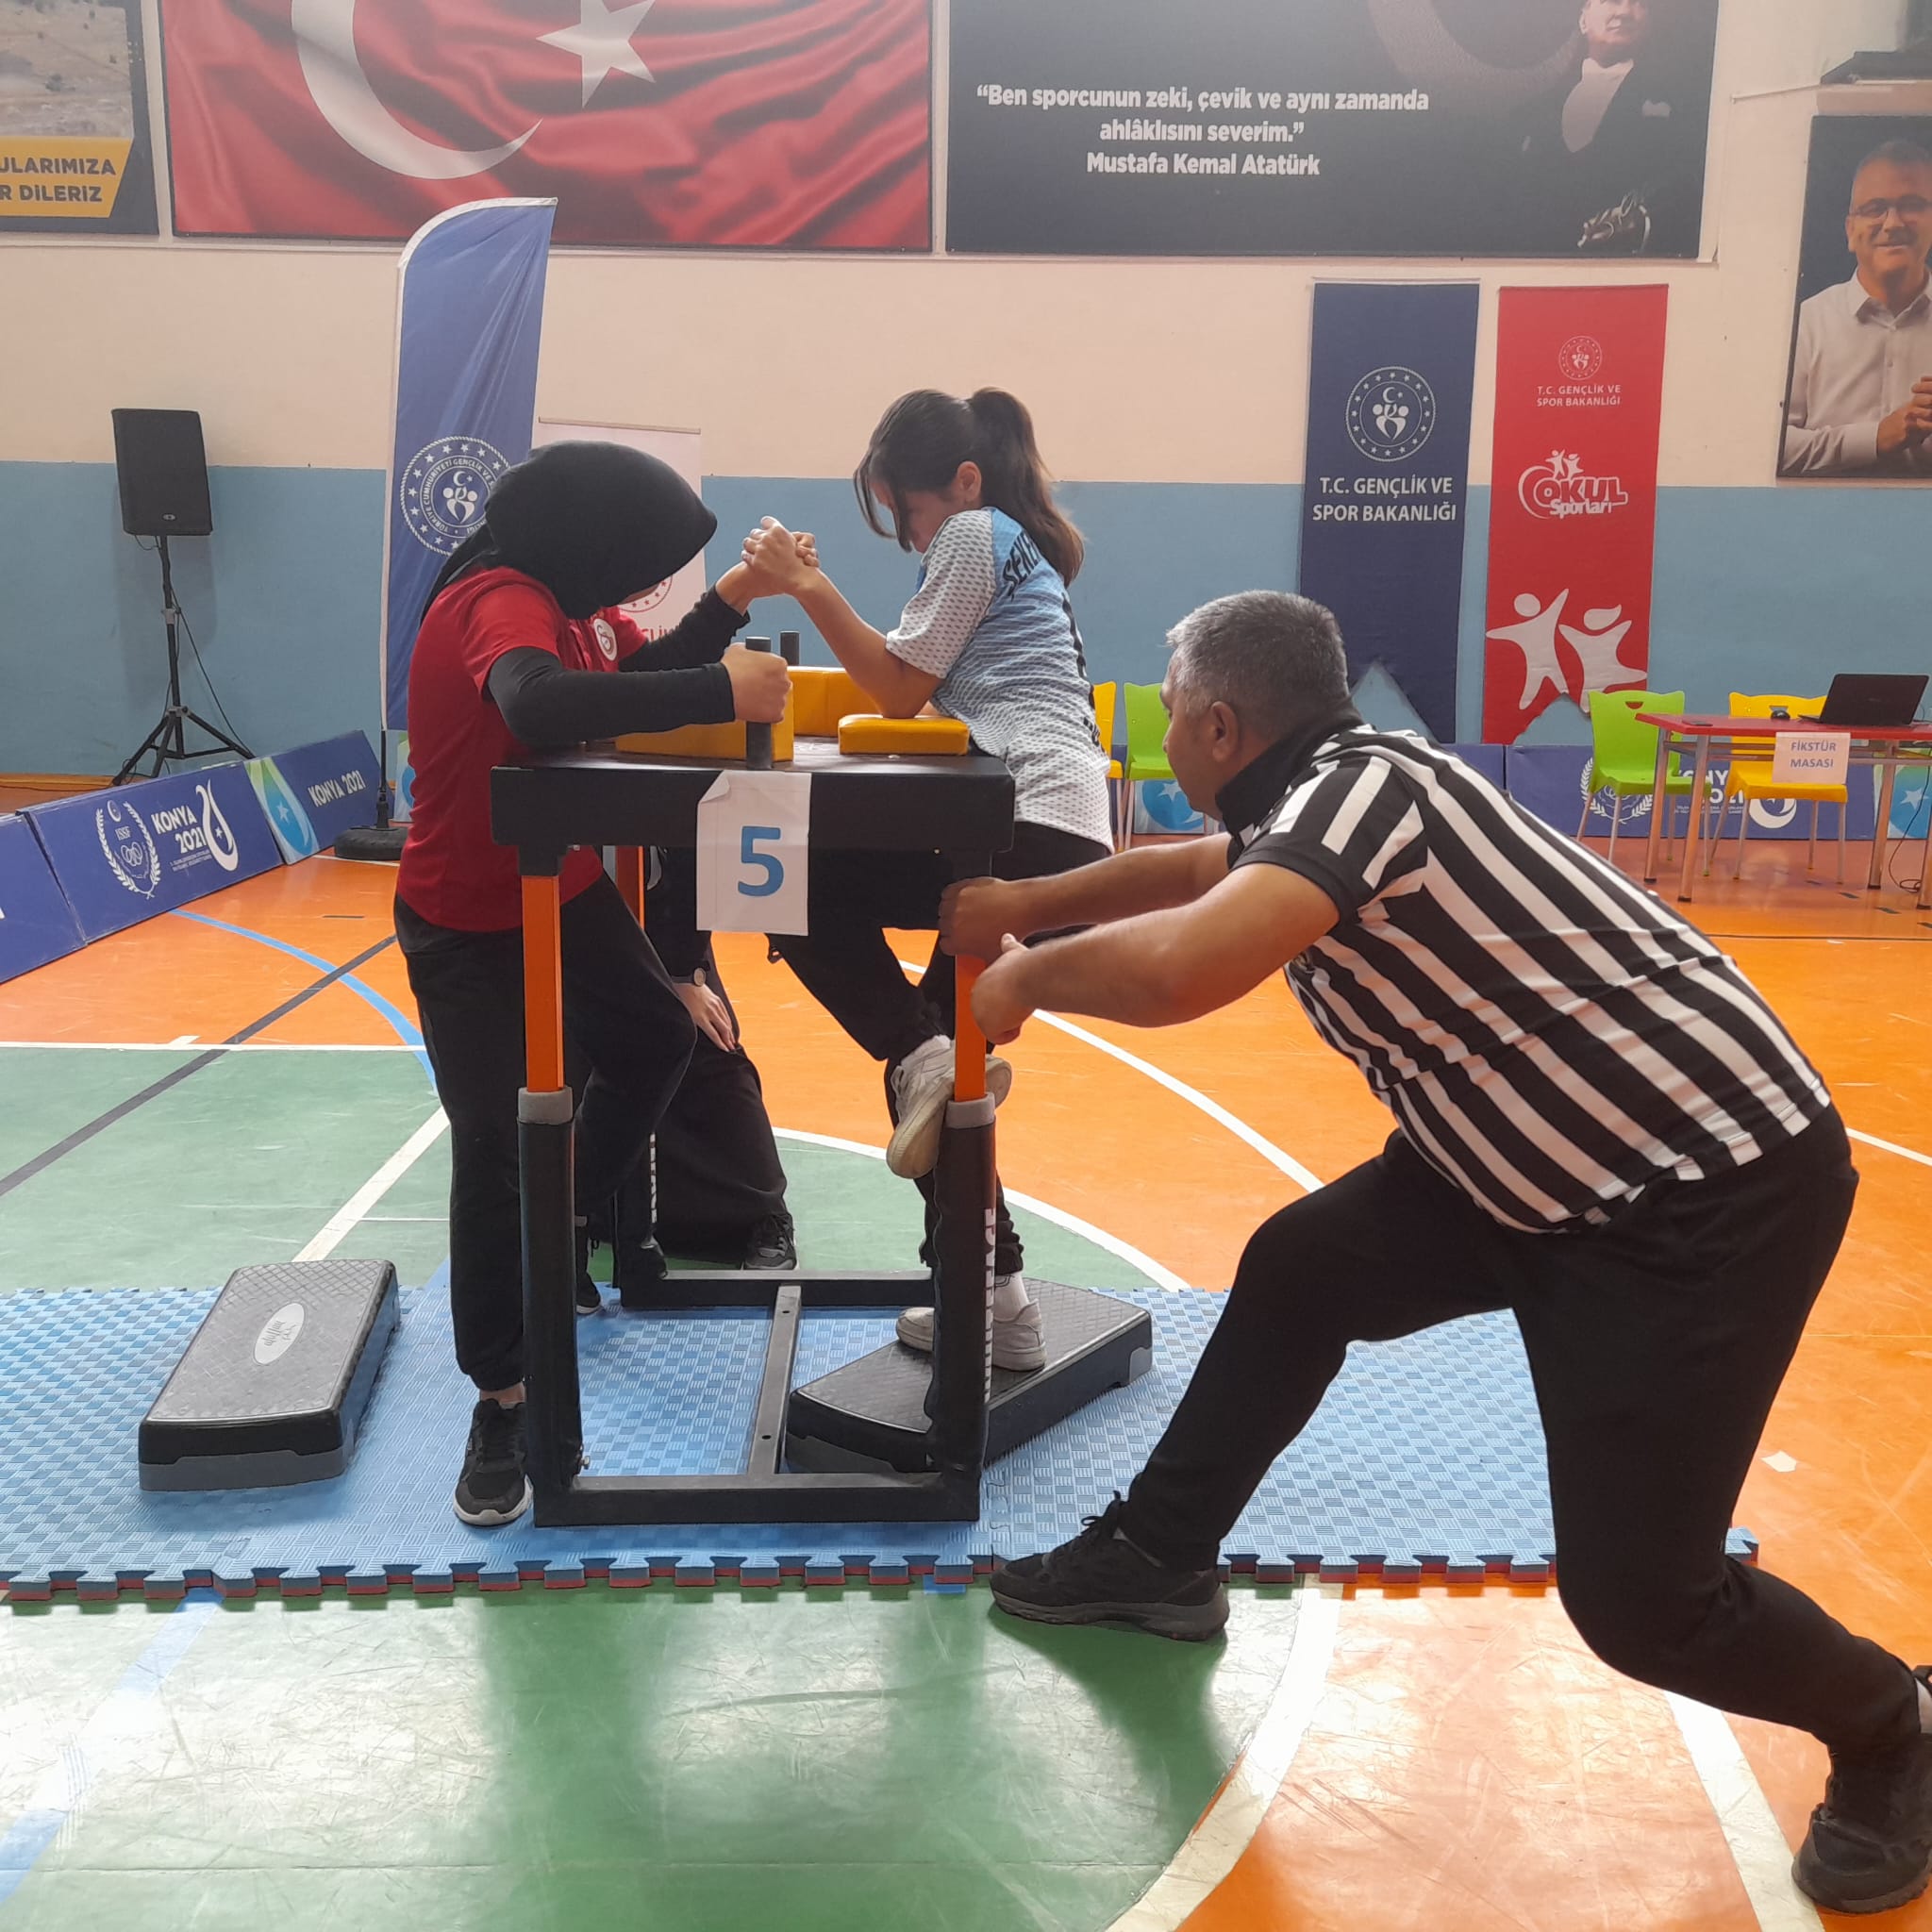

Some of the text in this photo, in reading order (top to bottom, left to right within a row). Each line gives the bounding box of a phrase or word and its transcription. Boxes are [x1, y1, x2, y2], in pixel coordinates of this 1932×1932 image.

[977, 85, 1429, 113] “Ben sporcunun zeki, çevik ve aynı zamanda
[1100, 119, 1304, 142] ahlâklısını severim.”
[1087, 152, 1321, 175] Mustafa Kemal Atatürk
[19, 184, 102, 202] DİLERİZ
[1537, 395, 1621, 407] SPOR BAKANLIĞI
[1538, 384, 1621, 396] T.C. GENÇLİK VE
[1320, 474, 1453, 498] T.C. GENÇLİK VE
[1533, 476, 1628, 508] OKUL
[1312, 501, 1457, 522] SPOR BAKANLIĞI
[1790, 740, 1837, 752] FİKSTÜR
[1790, 758, 1834, 768] MASASI
[307, 770, 366, 808] KONYA 2021
[151, 805, 197, 835] KONYA
[175, 826, 207, 854] 2021
[738, 825, 784, 896] 5
